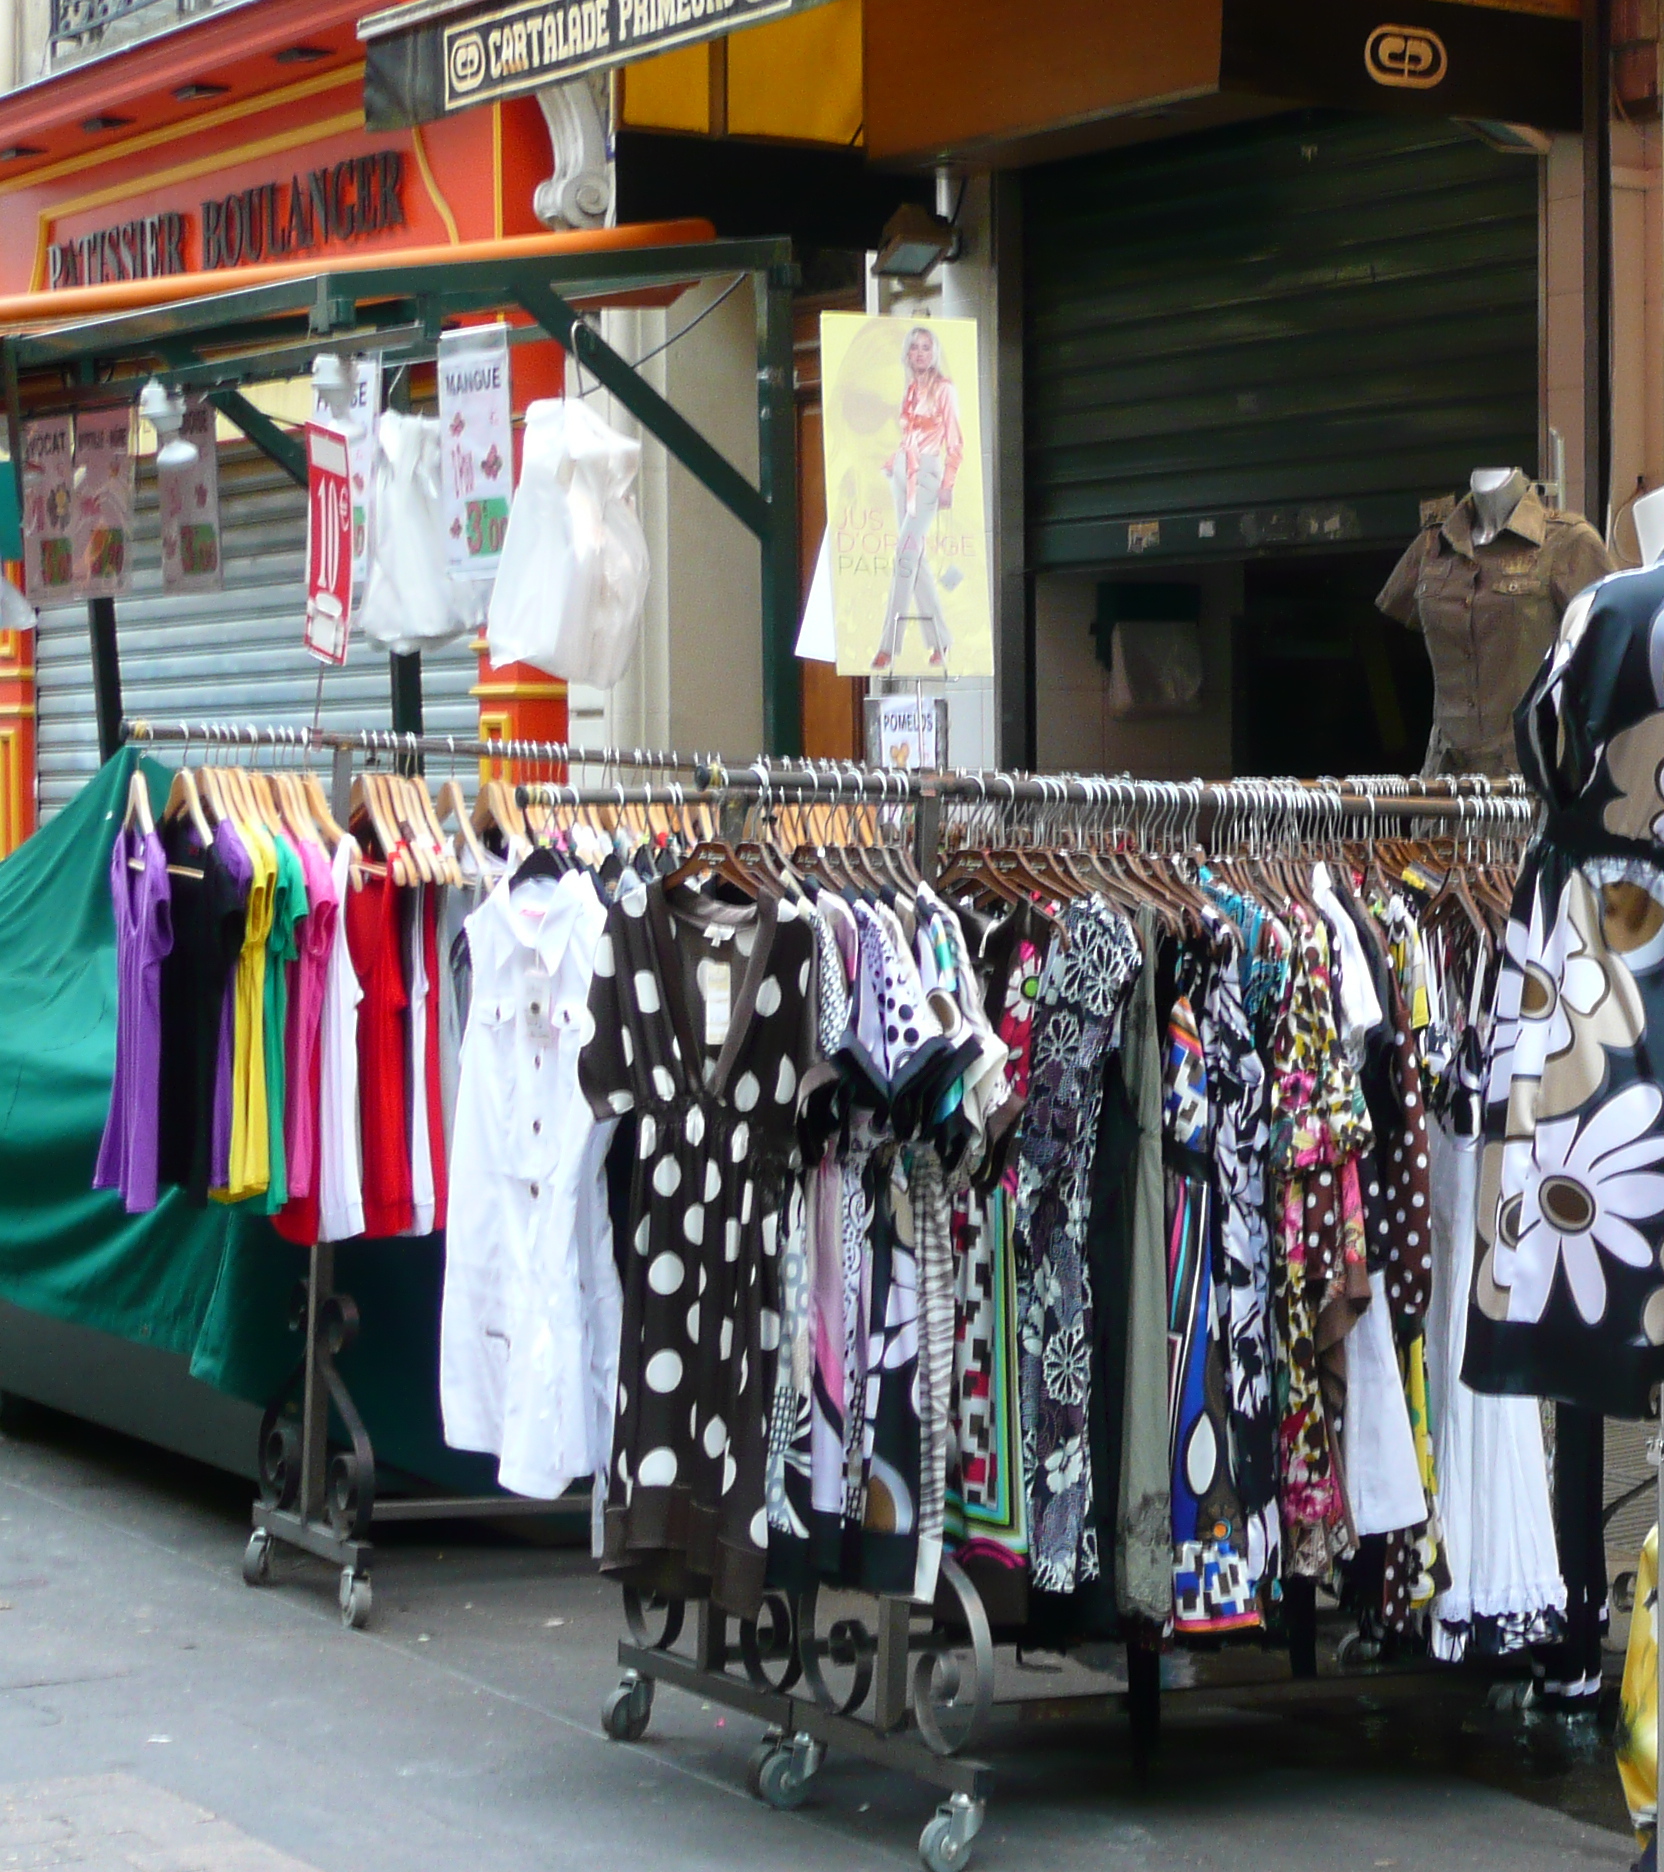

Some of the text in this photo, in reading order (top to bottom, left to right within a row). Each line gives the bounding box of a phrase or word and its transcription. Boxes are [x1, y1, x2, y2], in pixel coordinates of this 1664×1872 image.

[487, 0, 610, 80] CARTALADE
[201, 149, 405, 271] BOULANGER
[445, 367, 501, 396] MANGUE
[836, 506, 885, 532] JUS
[836, 531, 977, 558] D'ORANGE
[838, 555, 914, 579] PARIS
